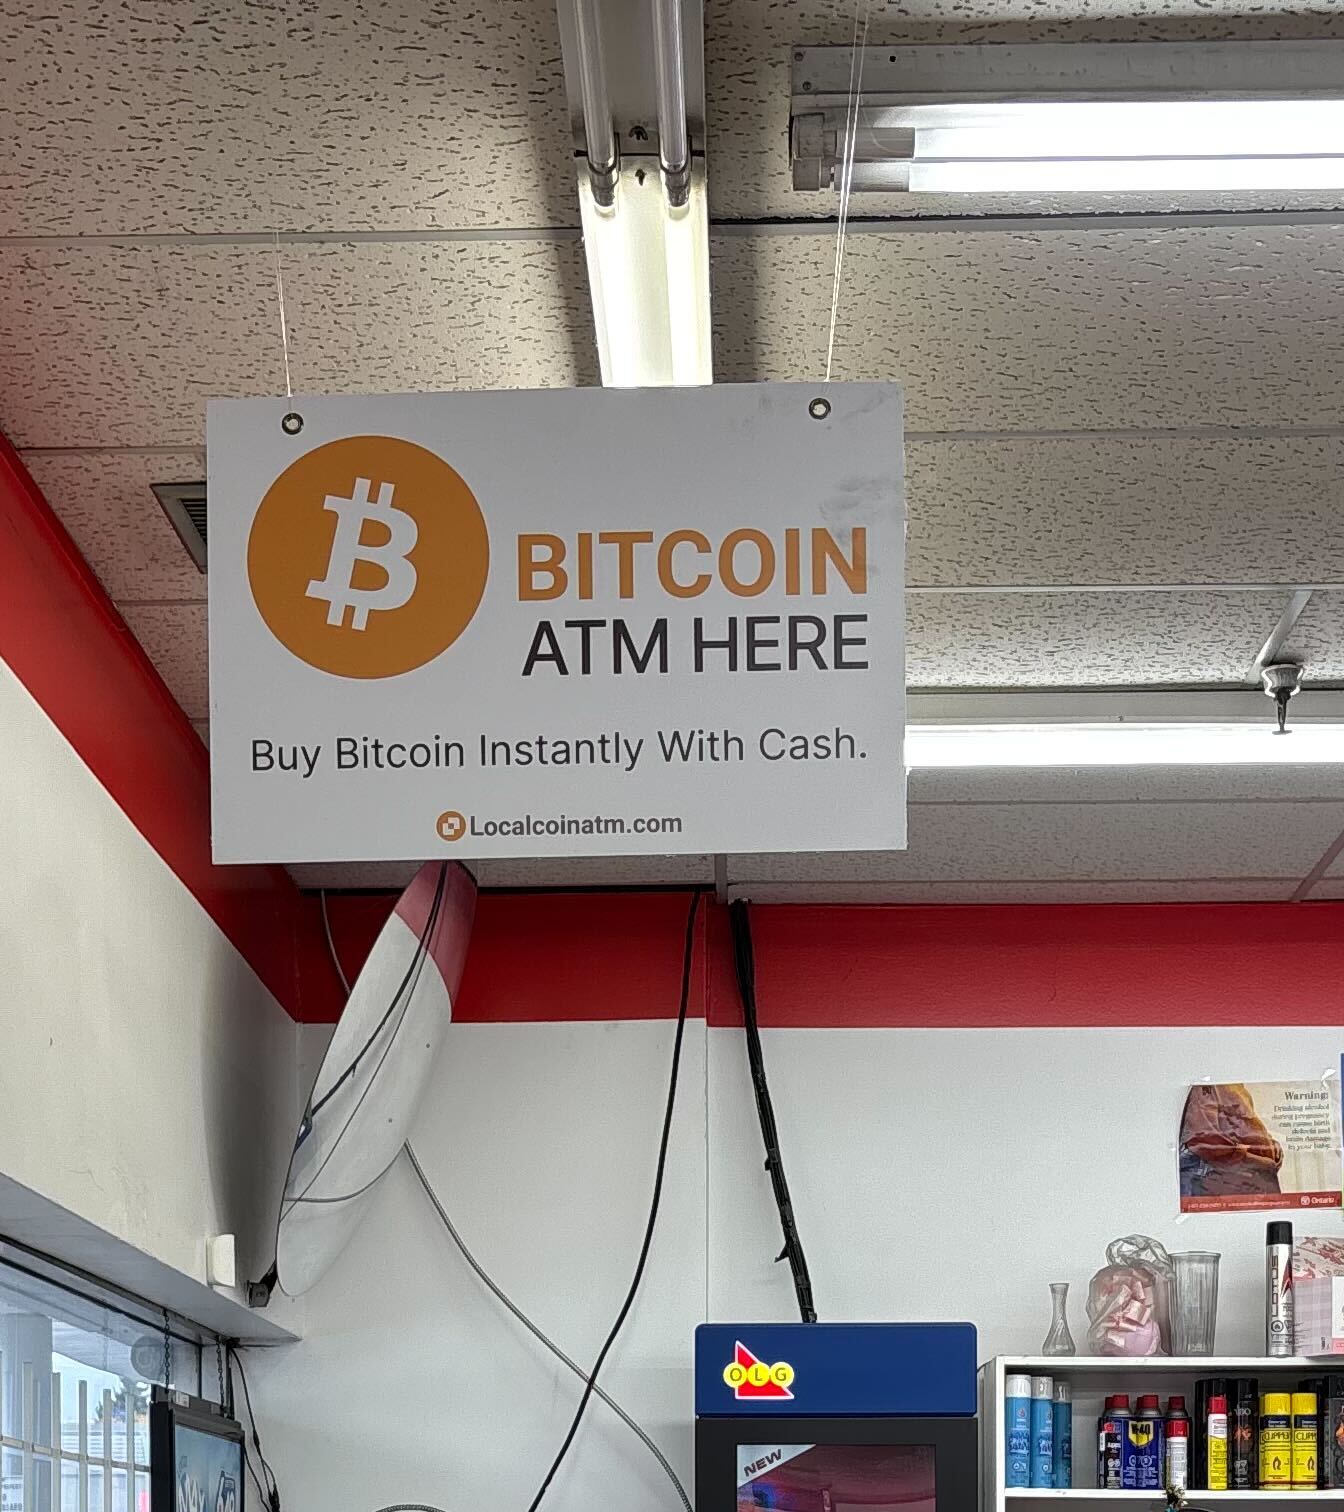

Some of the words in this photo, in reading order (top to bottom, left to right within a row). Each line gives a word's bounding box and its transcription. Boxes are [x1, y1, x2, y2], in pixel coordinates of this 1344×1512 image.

[518, 528, 867, 601] BITCOIN
[522, 619, 668, 676] ATM
[694, 615, 868, 672] HERE
[252, 739, 321, 778] Buy
[336, 734, 465, 770] Bitcoin
[480, 732, 644, 771] Instantly
[658, 729, 744, 762] With
[760, 725, 867, 761] Cash.
[470, 812, 682, 836] Localcoinatm.com
[1285, 1091, 1329, 1101] Warning:
[730, 1367, 787, 1382] OLG
[743, 1449, 782, 1477] NEW
